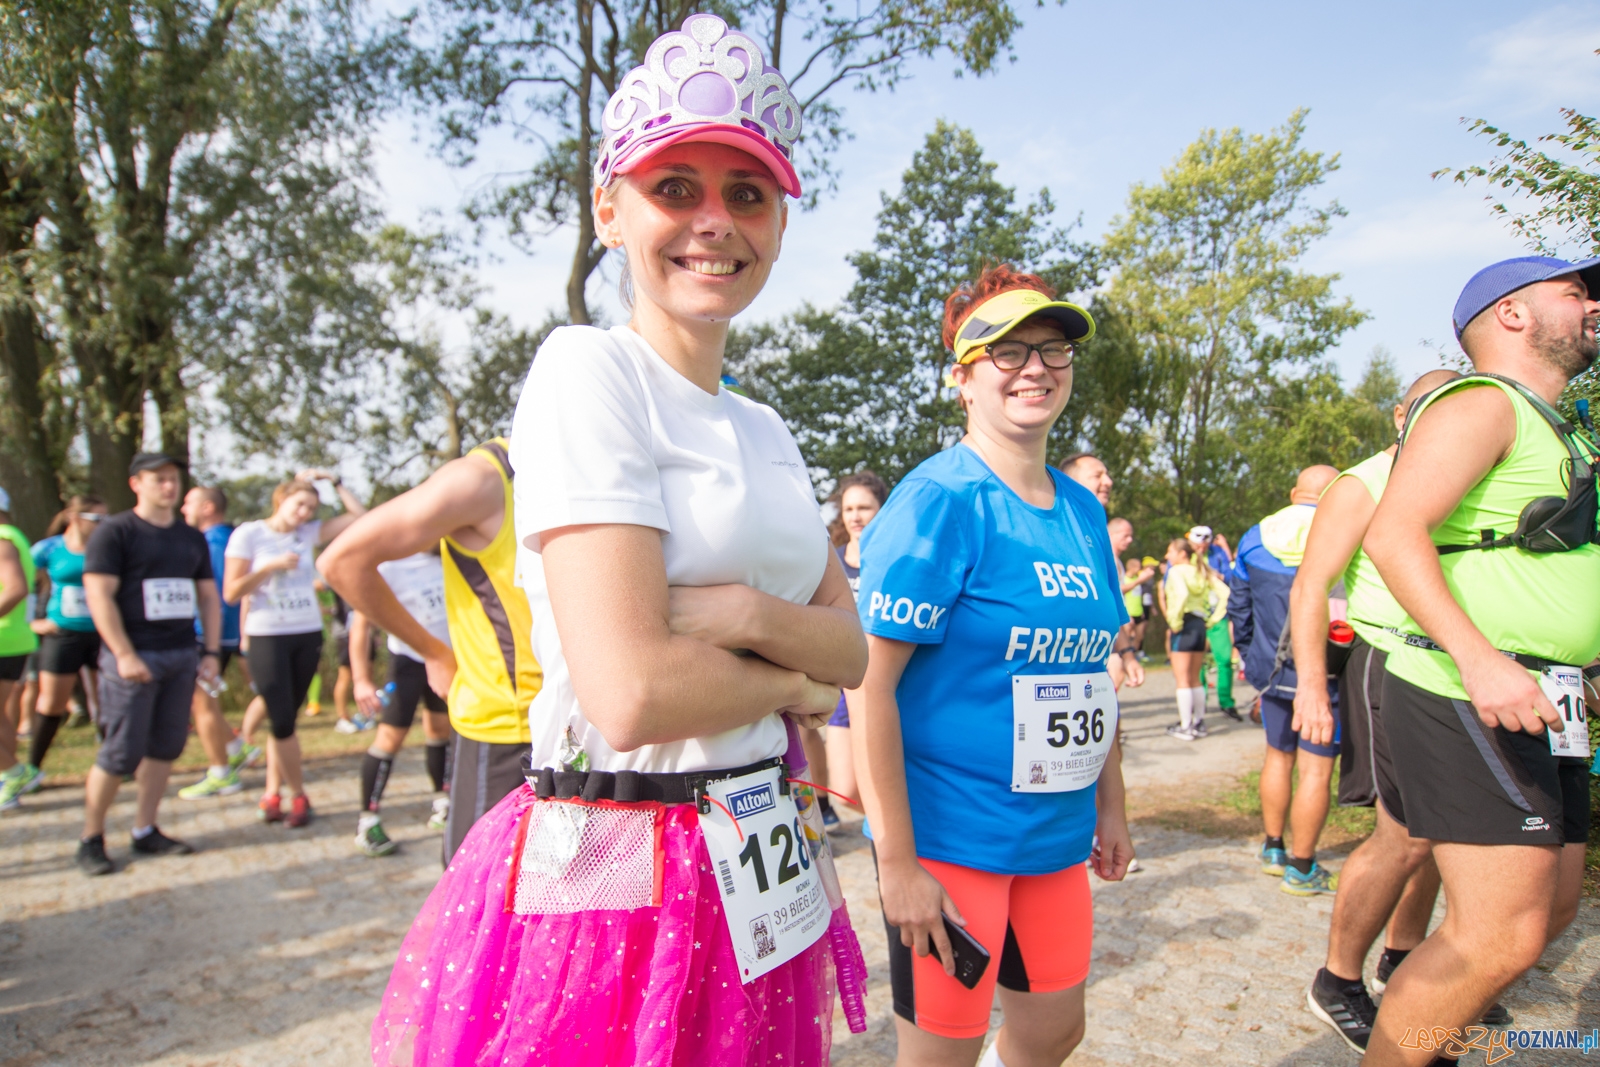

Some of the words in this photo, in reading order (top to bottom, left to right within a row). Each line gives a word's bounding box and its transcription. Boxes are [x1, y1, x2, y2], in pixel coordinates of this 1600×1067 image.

[1033, 561, 1099, 601] BEST
[868, 591, 947, 630] PŁOCK
[1046, 708, 1104, 748] 536
[1051, 761, 1063, 771] 39
[1065, 758, 1084, 770] BIEG
[739, 816, 813, 893] 128
[773, 907, 788, 925] 39
[789, 894, 810, 917] BIEG
